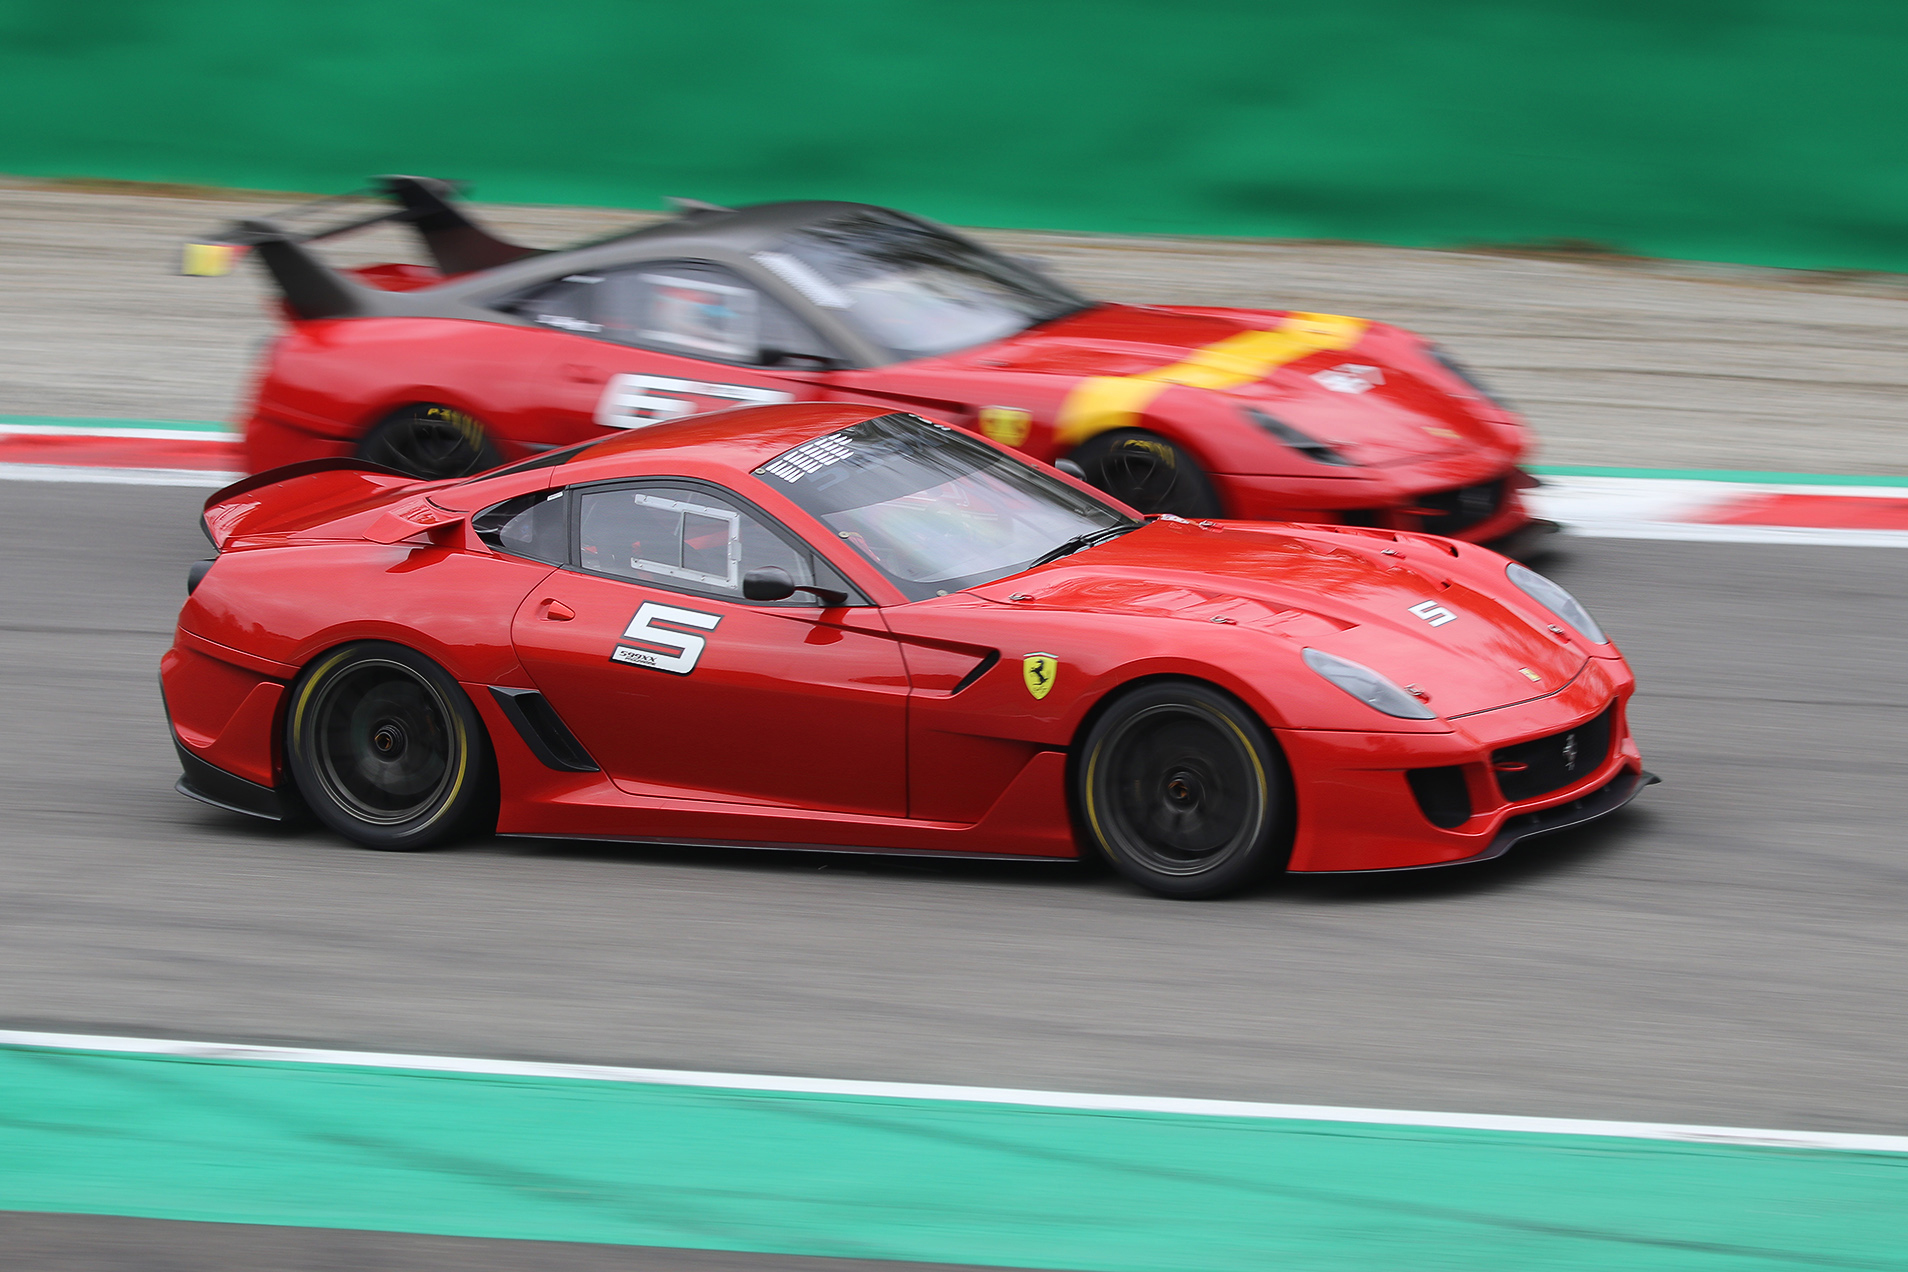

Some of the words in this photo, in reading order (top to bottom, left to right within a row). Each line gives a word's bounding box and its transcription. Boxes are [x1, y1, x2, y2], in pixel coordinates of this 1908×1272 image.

[1407, 599, 1458, 628] 5
[609, 600, 724, 676] 5
[619, 650, 657, 662] 599XX
